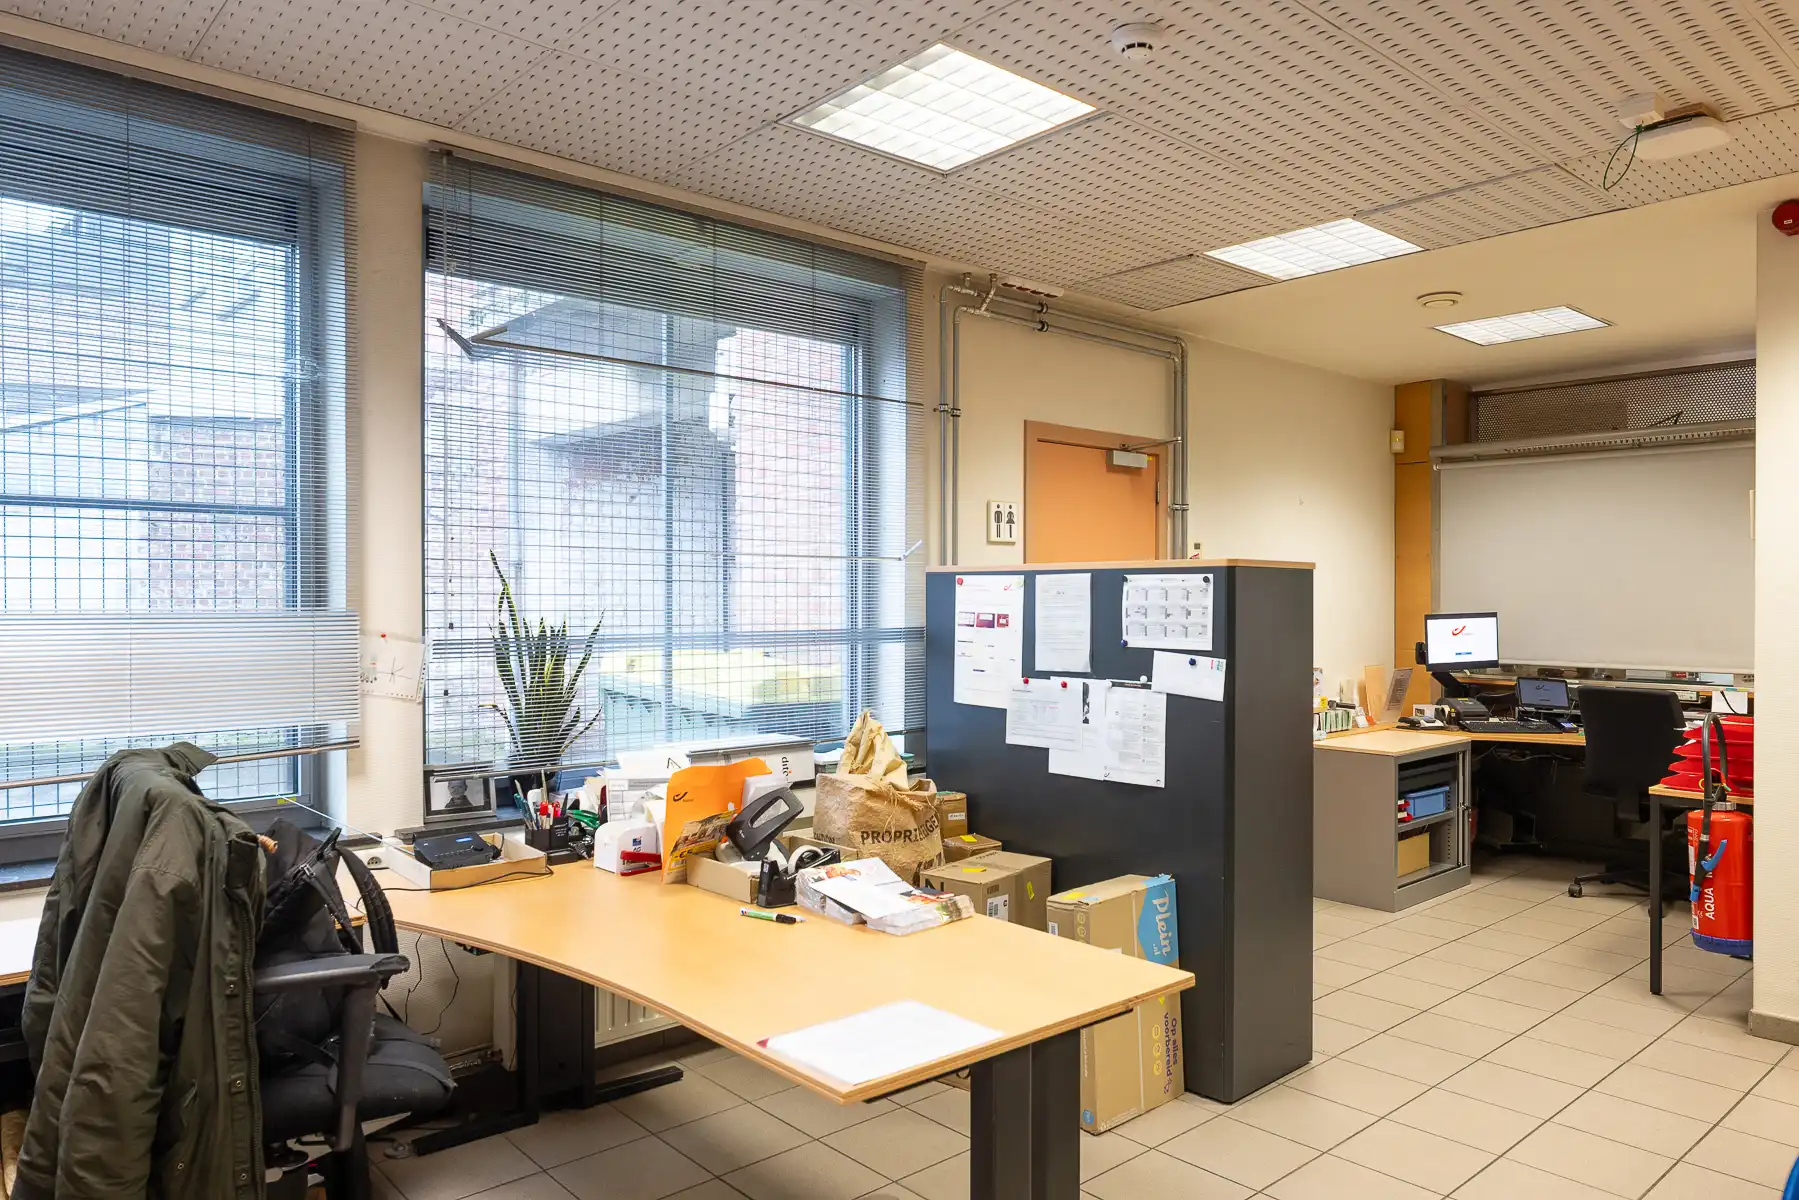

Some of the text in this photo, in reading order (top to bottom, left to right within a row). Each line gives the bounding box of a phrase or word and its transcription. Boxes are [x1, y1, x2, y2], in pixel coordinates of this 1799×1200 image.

[1704, 888, 1715, 920] AQUA
[1170, 1018, 1178, 1036] Op
[1163, 1012, 1173, 1077] voorbereid
